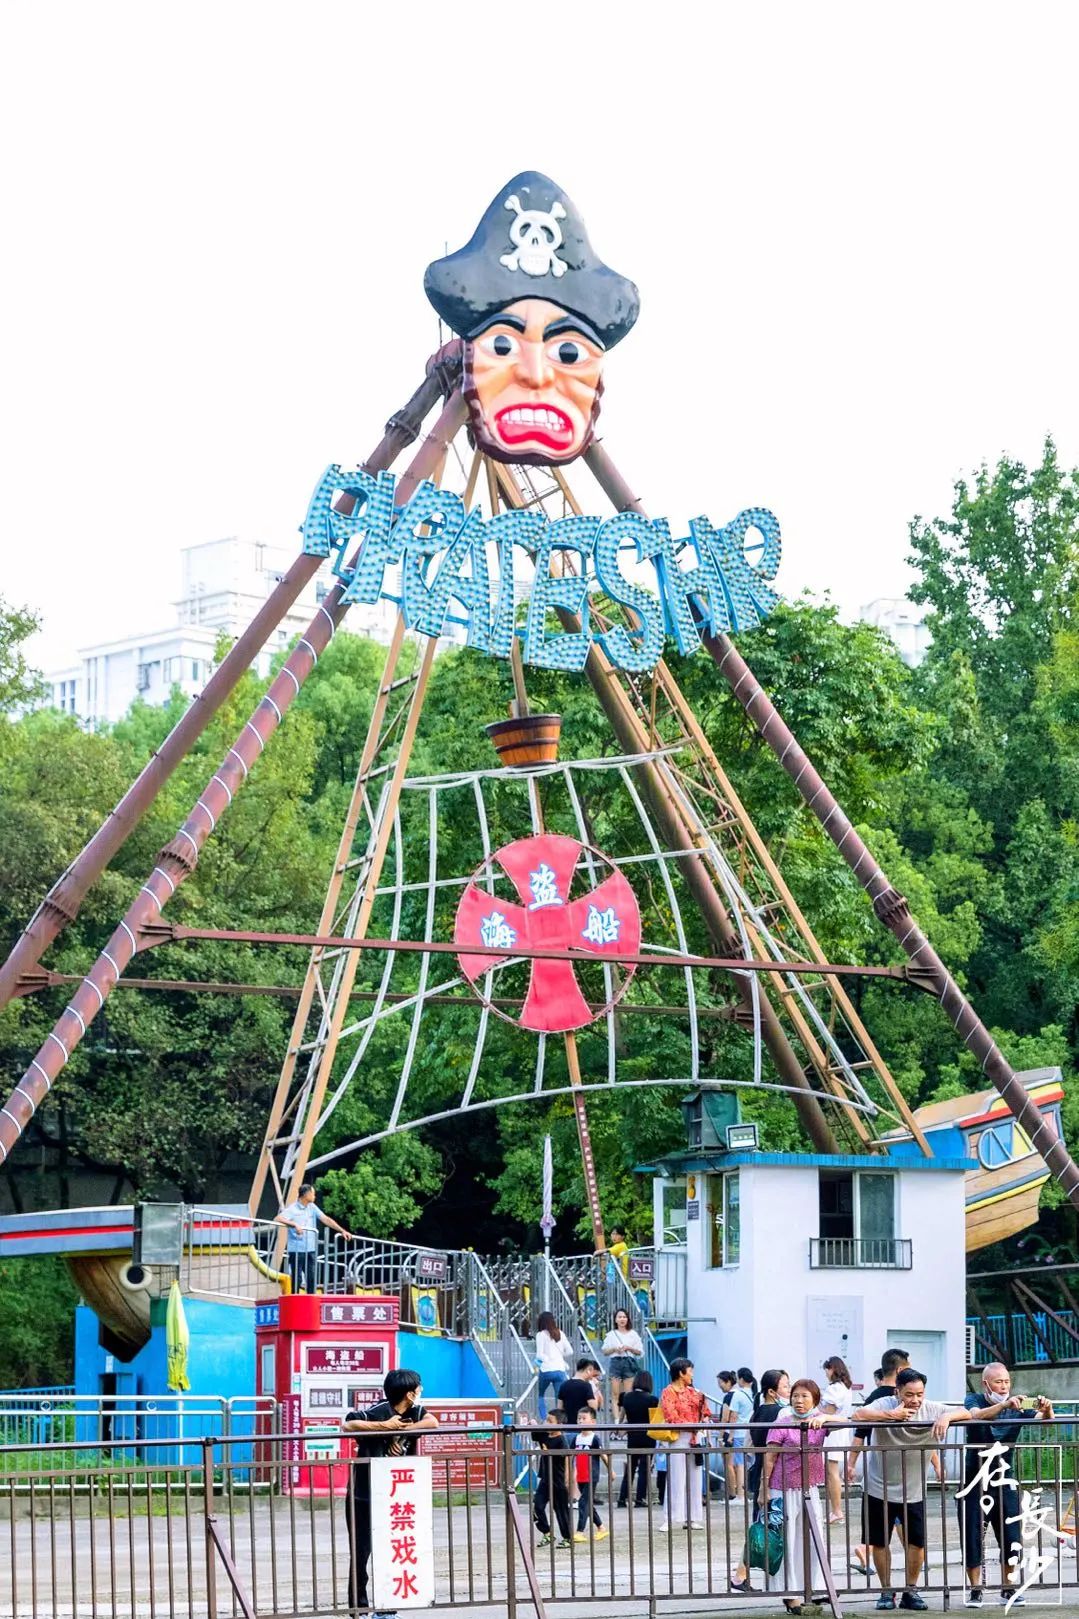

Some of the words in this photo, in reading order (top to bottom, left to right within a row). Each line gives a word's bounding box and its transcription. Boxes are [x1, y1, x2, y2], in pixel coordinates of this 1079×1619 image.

[422, 1260, 443, 1272] 出口
[631, 1263, 651, 1273] 入口
[331, 1306, 387, 1321] 售票处
[325, 1350, 365, 1361] 海盗船
[389, 1468, 419, 1600] 严禁戏水
